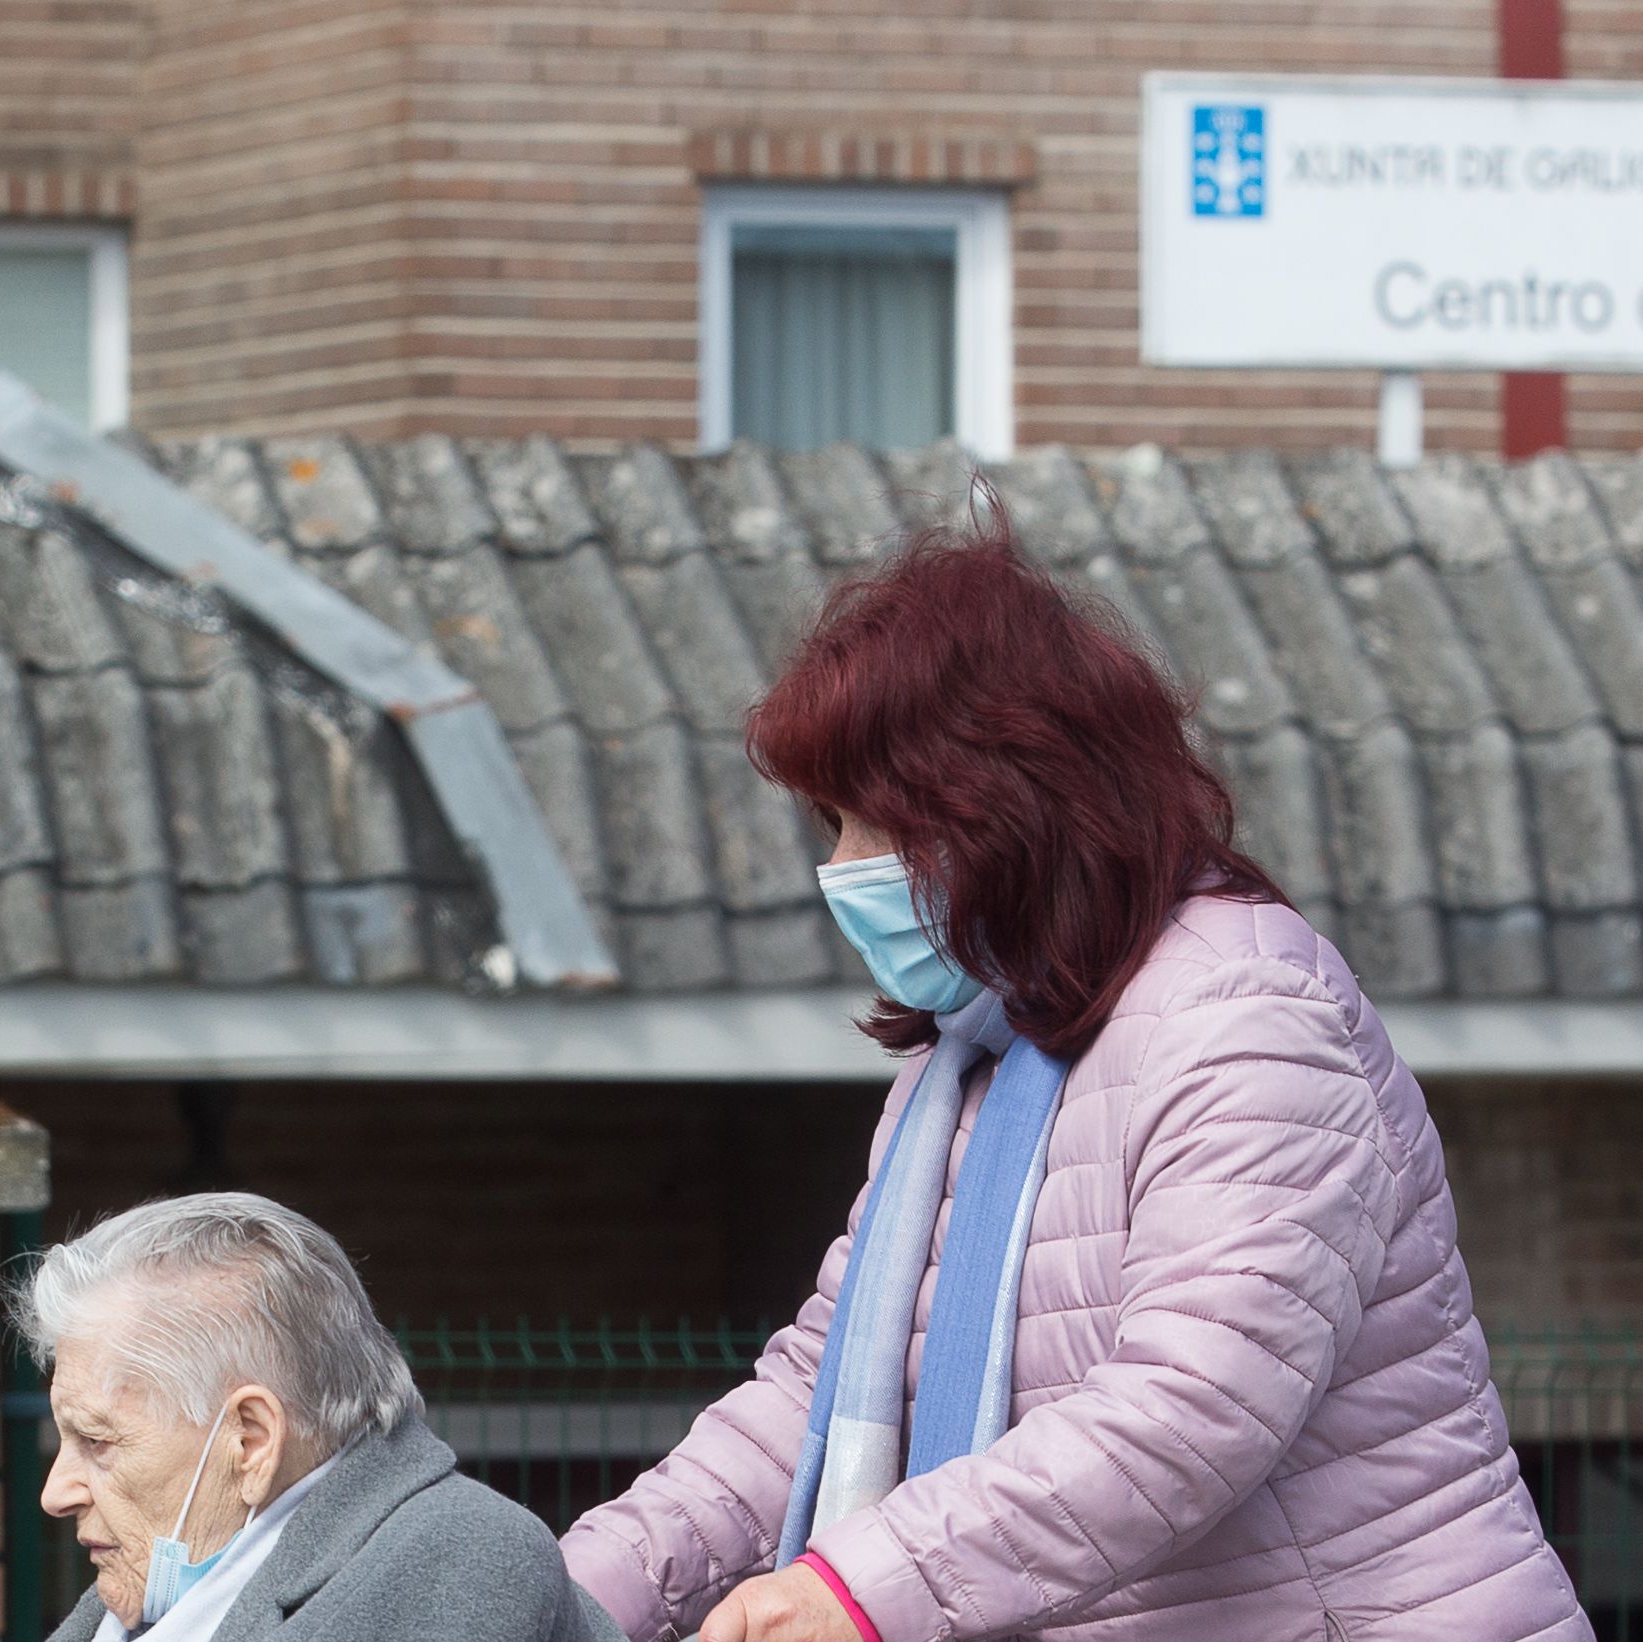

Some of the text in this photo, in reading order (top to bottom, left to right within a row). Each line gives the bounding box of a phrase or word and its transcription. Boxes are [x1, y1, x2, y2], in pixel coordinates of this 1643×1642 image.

[1288, 145, 1443, 187] XUNTA
[1460, 147, 1509, 188] DE
[1375, 260, 1614, 334] Centro
